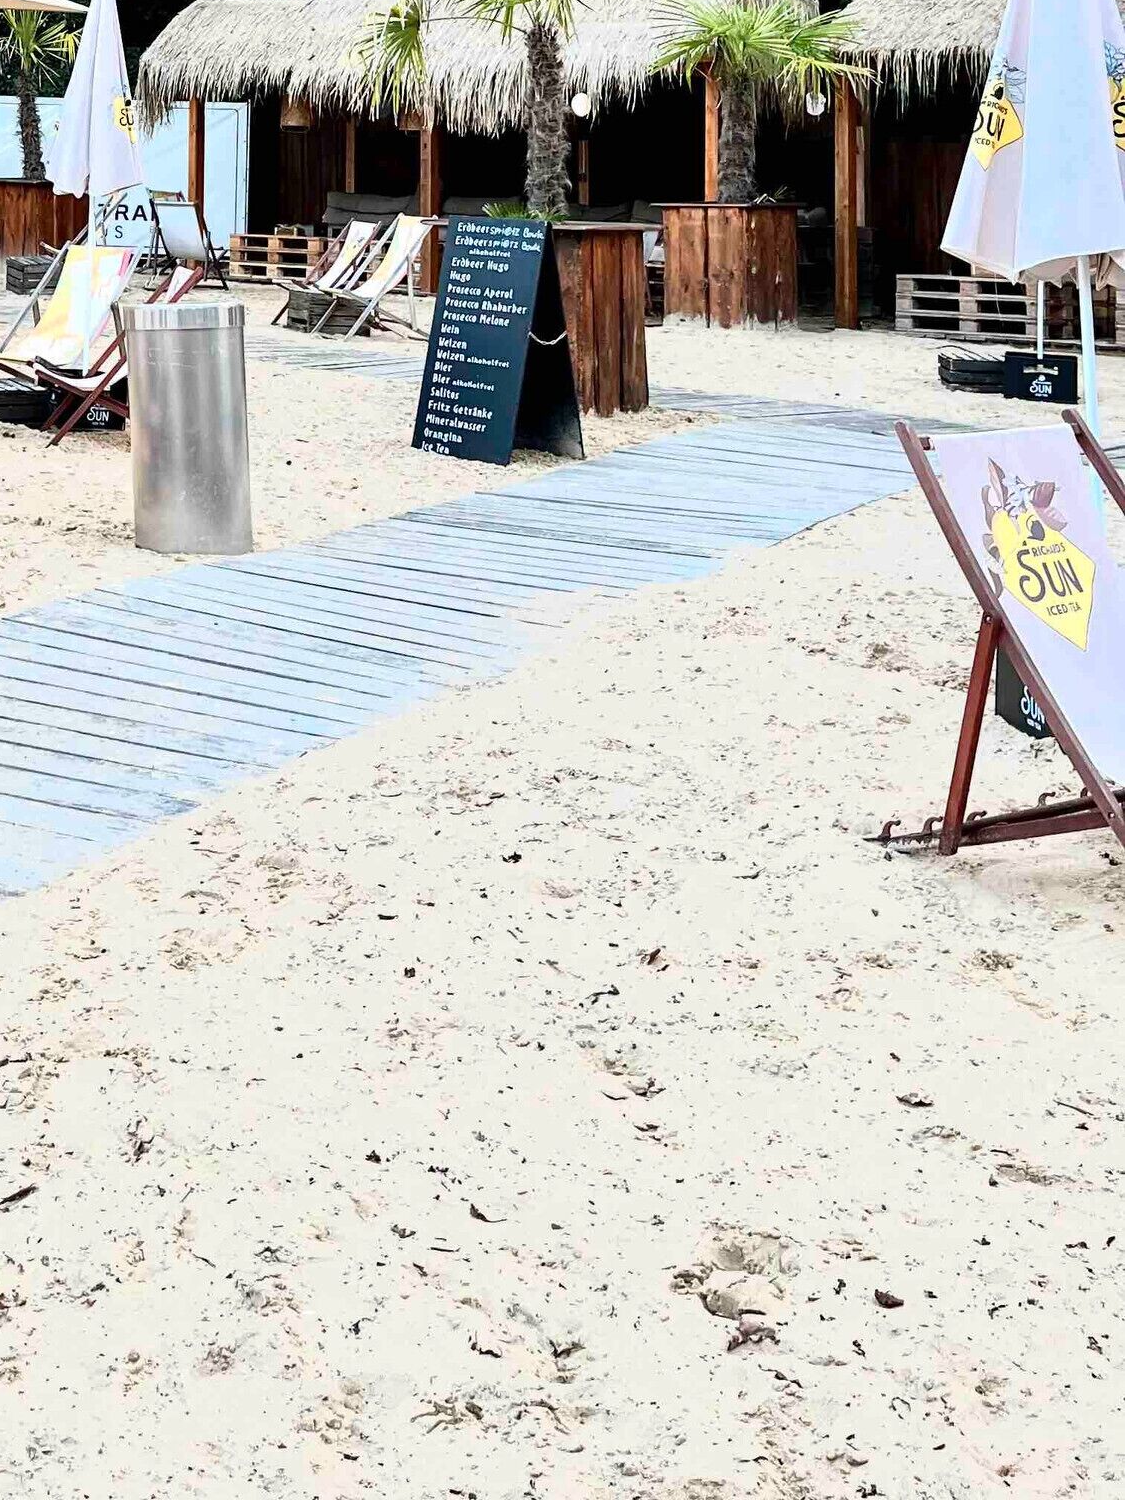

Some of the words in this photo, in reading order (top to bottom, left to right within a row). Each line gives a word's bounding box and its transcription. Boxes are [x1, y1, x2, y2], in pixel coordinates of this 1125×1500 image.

[451, 257, 484, 269] Erdbeer
[487, 260, 509, 272] Hugo
[449, 270, 471, 282] Hugo
[447, 283, 481, 296] Prosecco
[483, 287, 514, 299] Aperol
[445, 296, 479, 309] Prosecco
[481, 300, 528, 315] Rhabarber
[443, 309, 477, 323] Prosecco
[479, 314, 510, 327] Melone
[440, 323, 460, 335] Wein
[438, 337, 467, 350] Weizen
[436, 349, 465, 362] Weizen
[434, 361, 453, 372] Bier
[432, 373, 451, 384] Bier
[430, 386, 460, 399] Salitos
[1029, 381, 1052, 394] SUN
[428, 400, 451, 412] Fritz
[86, 406, 110, 421] SUN
[425, 413, 487, 432] Mineralwasser
[423, 427, 463, 443] Orangina
[421, 440, 434, 451] Ice
[436, 443, 450, 454] Tea
[1016, 549, 1084, 602] SUN
[1046, 603, 1068, 616] ICED
